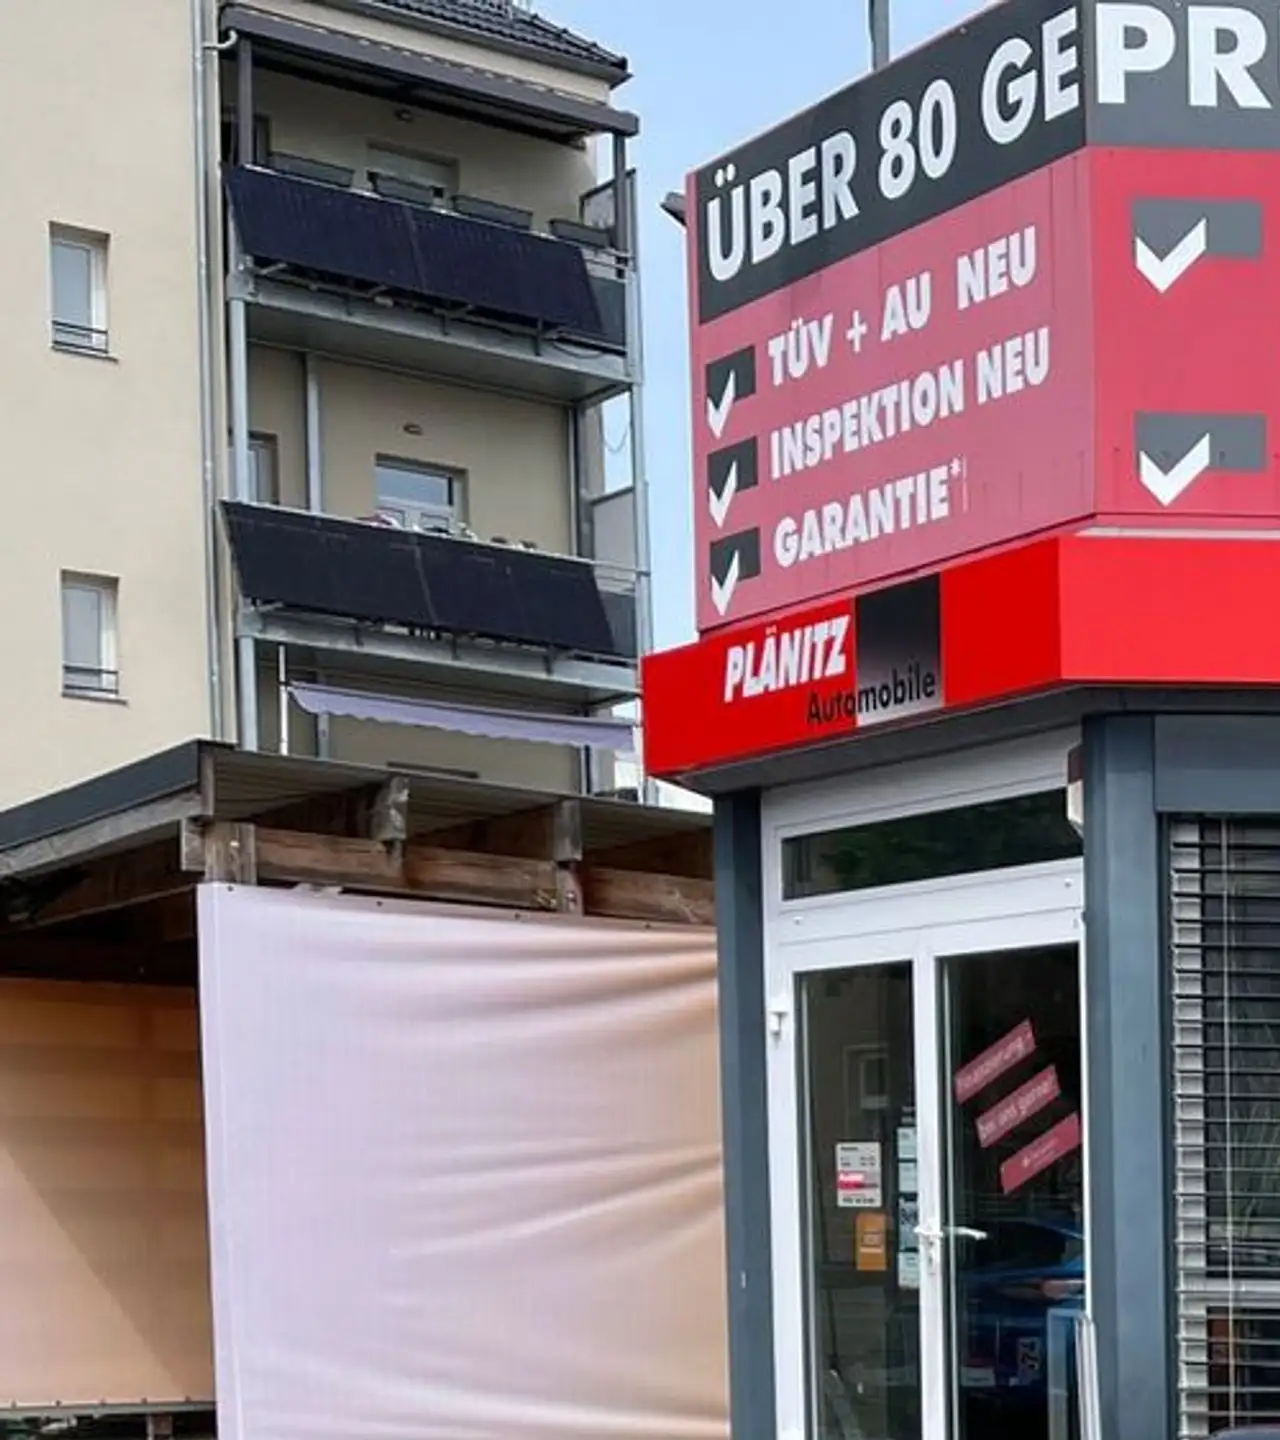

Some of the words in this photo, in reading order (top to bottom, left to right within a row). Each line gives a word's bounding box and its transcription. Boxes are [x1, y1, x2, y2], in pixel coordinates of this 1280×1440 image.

[707, 131, 857, 281] ÜBER
[878, 79, 956, 199] 80
[768, 312, 833, 386] TÜV
[846, 310, 867, 352] +
[881, 272, 931, 342] AU
[957, 226, 1036, 310] NEU
[771, 360, 964, 480] INSPEKTION
[976, 327, 1049, 405] NEU
[724, 613, 850, 703] PLÄNITZ
[807, 663, 936, 726] Automobile
